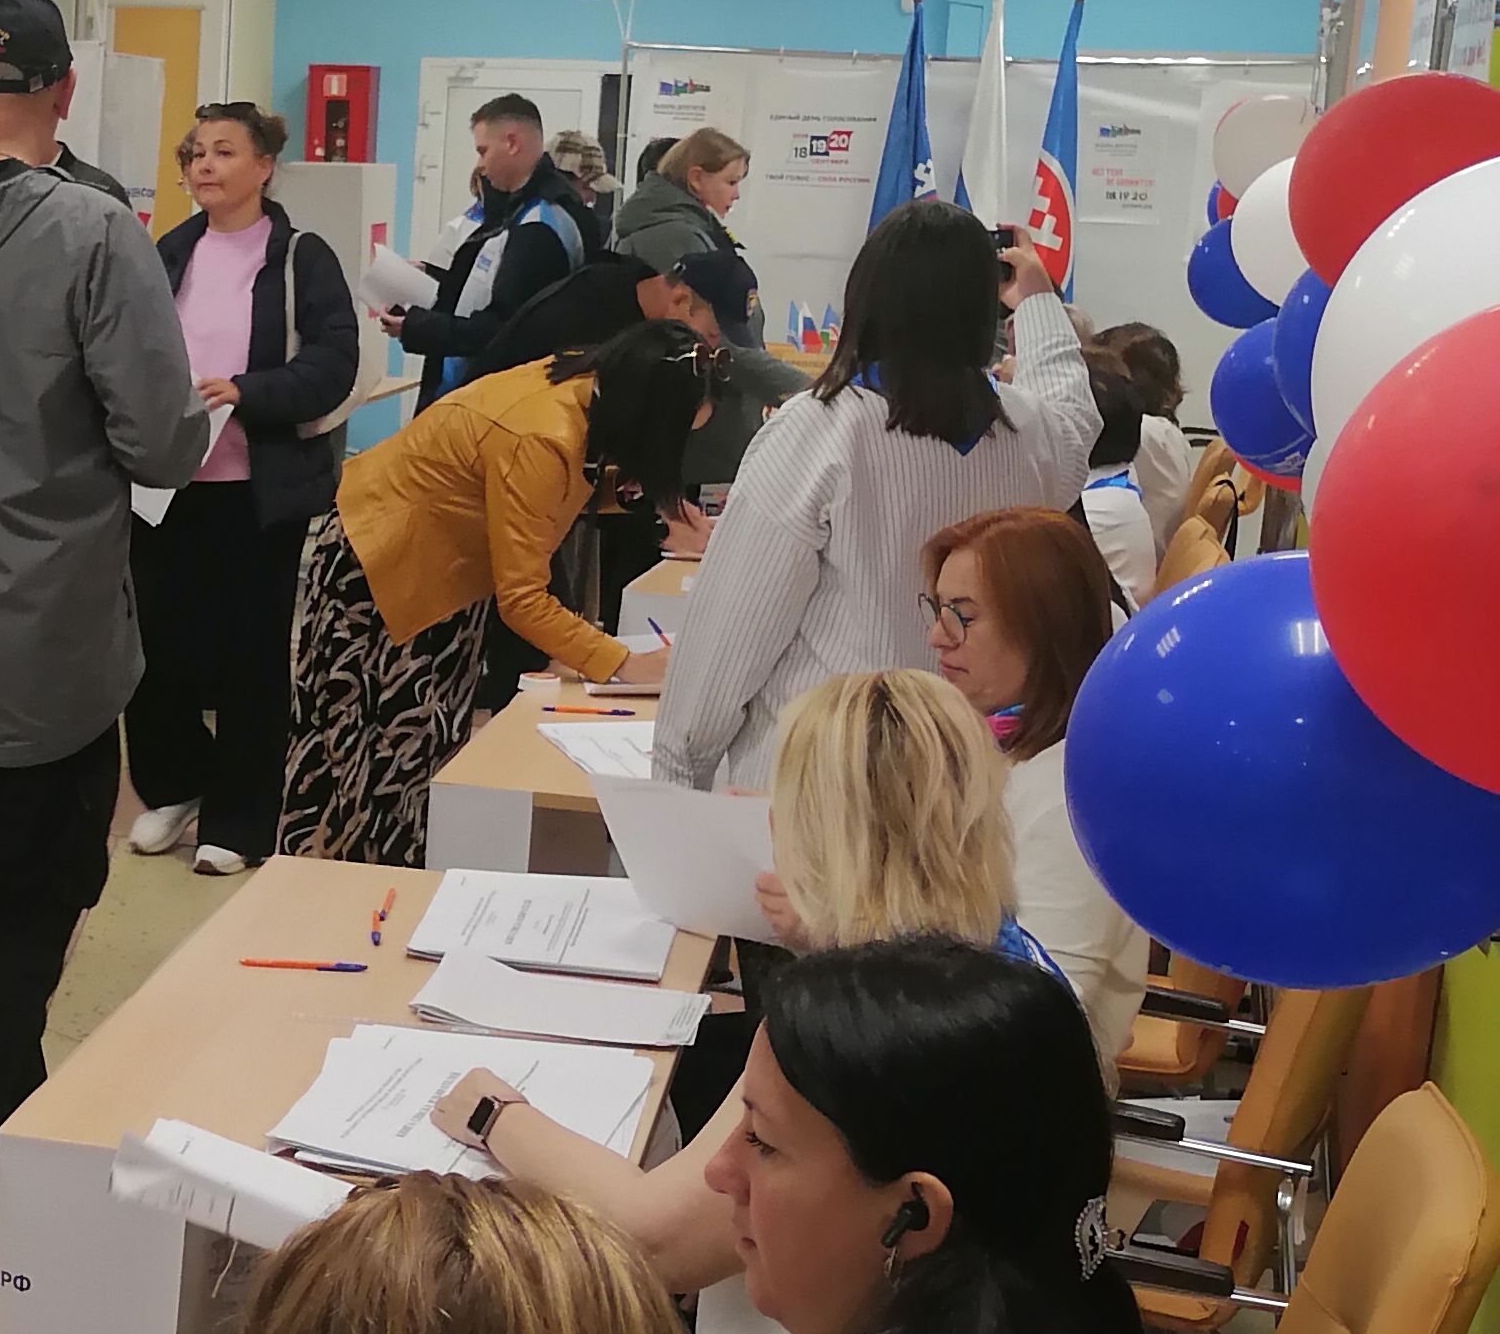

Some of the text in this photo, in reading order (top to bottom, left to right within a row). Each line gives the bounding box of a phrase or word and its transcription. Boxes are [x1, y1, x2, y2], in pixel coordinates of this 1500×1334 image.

[794, 133, 849, 158] 18 19 20
